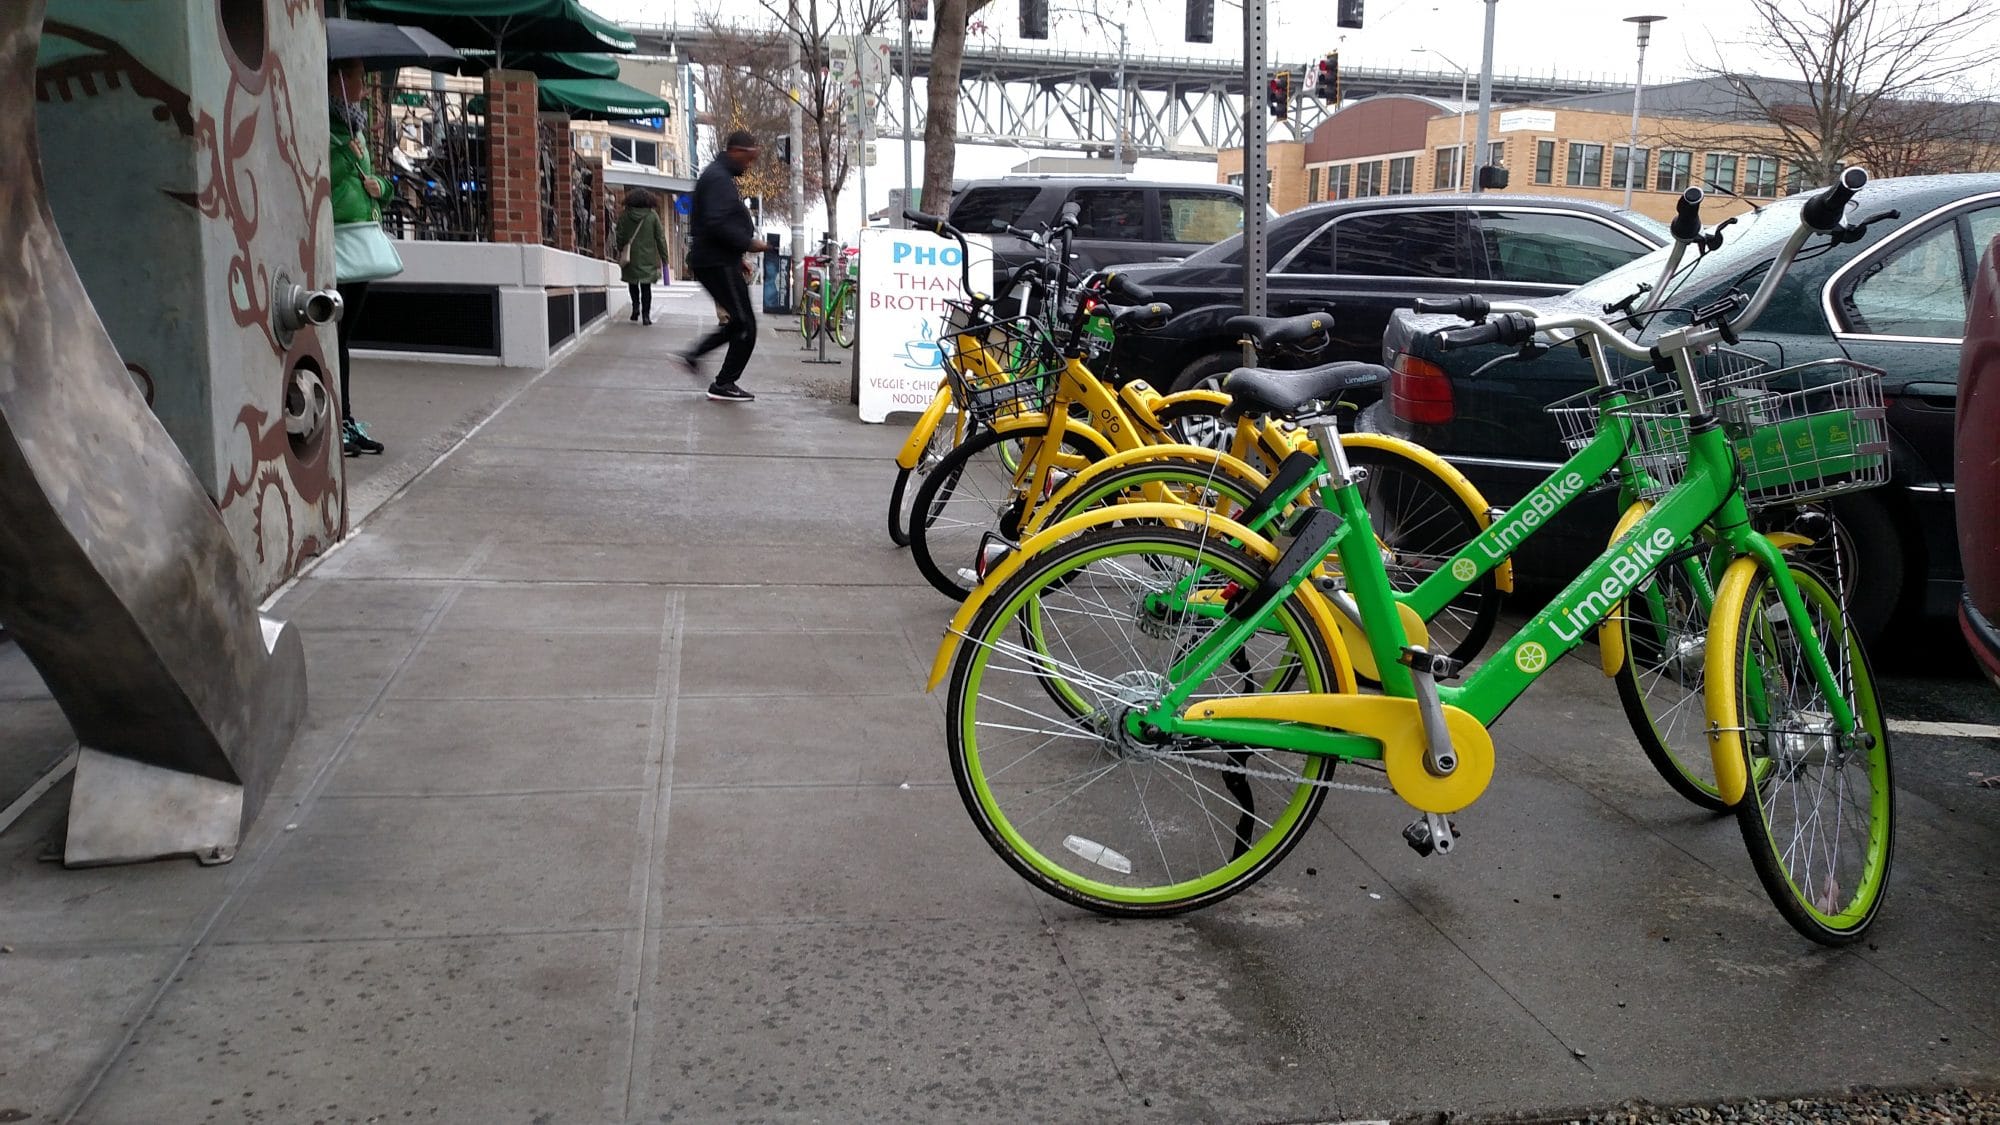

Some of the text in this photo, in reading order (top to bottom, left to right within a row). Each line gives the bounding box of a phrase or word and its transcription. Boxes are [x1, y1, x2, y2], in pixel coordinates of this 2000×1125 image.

[893, 241, 963, 266] PHO
[893, 272, 962, 292] THAN
[870, 377, 905, 390] VEGGIE
[1101, 409, 1120, 433] ofo
[1478, 471, 1585, 559] LimeBike
[1548, 527, 1676, 642] LimeBike
